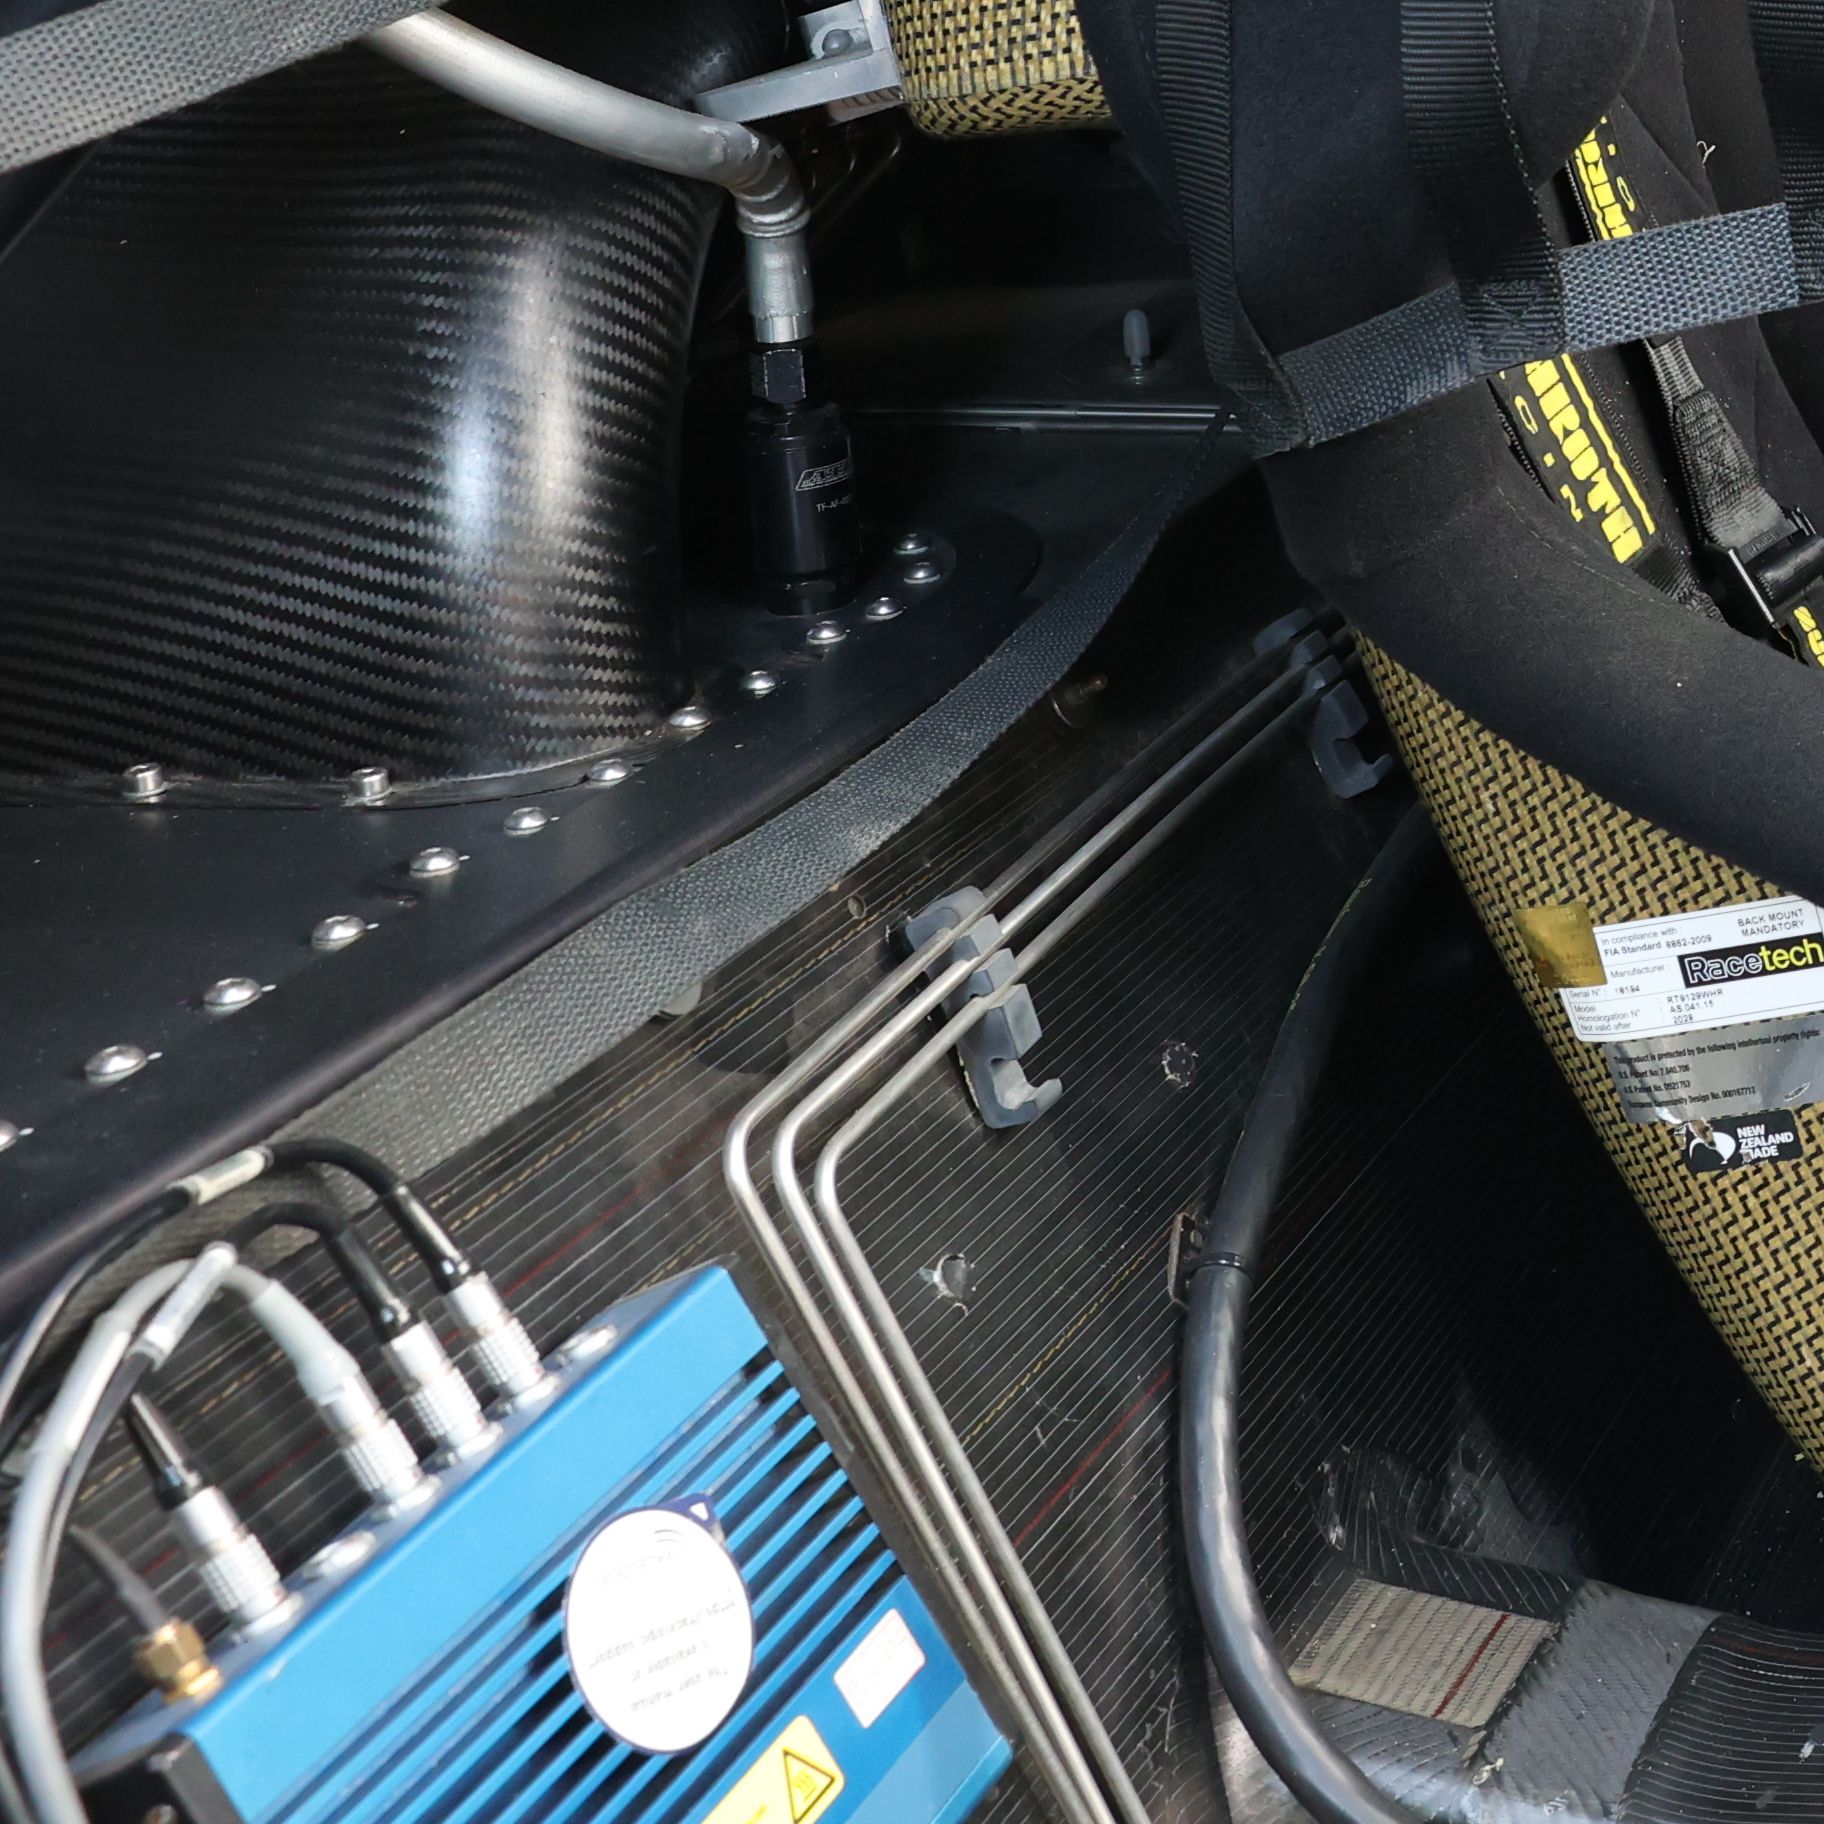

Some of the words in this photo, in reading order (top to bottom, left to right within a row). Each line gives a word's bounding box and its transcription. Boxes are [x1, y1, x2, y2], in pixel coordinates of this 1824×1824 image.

[1737, 914, 1766, 927] BACK
[1768, 909, 1804, 924] MOUNT
[1741, 919, 1805, 937] MANDATORY
[1611, 930, 1659, 947] compliance
[1660, 927, 1678, 938] with
[1604, 948, 1620, 957] FIA
[1622, 941, 1662, 955] Standard
[1610, 964, 1665, 979] Manufacturer
[1568, 988, 1590, 998] Serial
[1573, 1003, 1596, 1014] Model
[1577, 1010, 1629, 1026] Homologation
[1657, 1049, 1687, 1061] protected
[1706, 1041, 1736, 1051] following
[1737, 1124, 1765, 1139] NEW
[1739, 1132, 1794, 1149] ZEALAND
